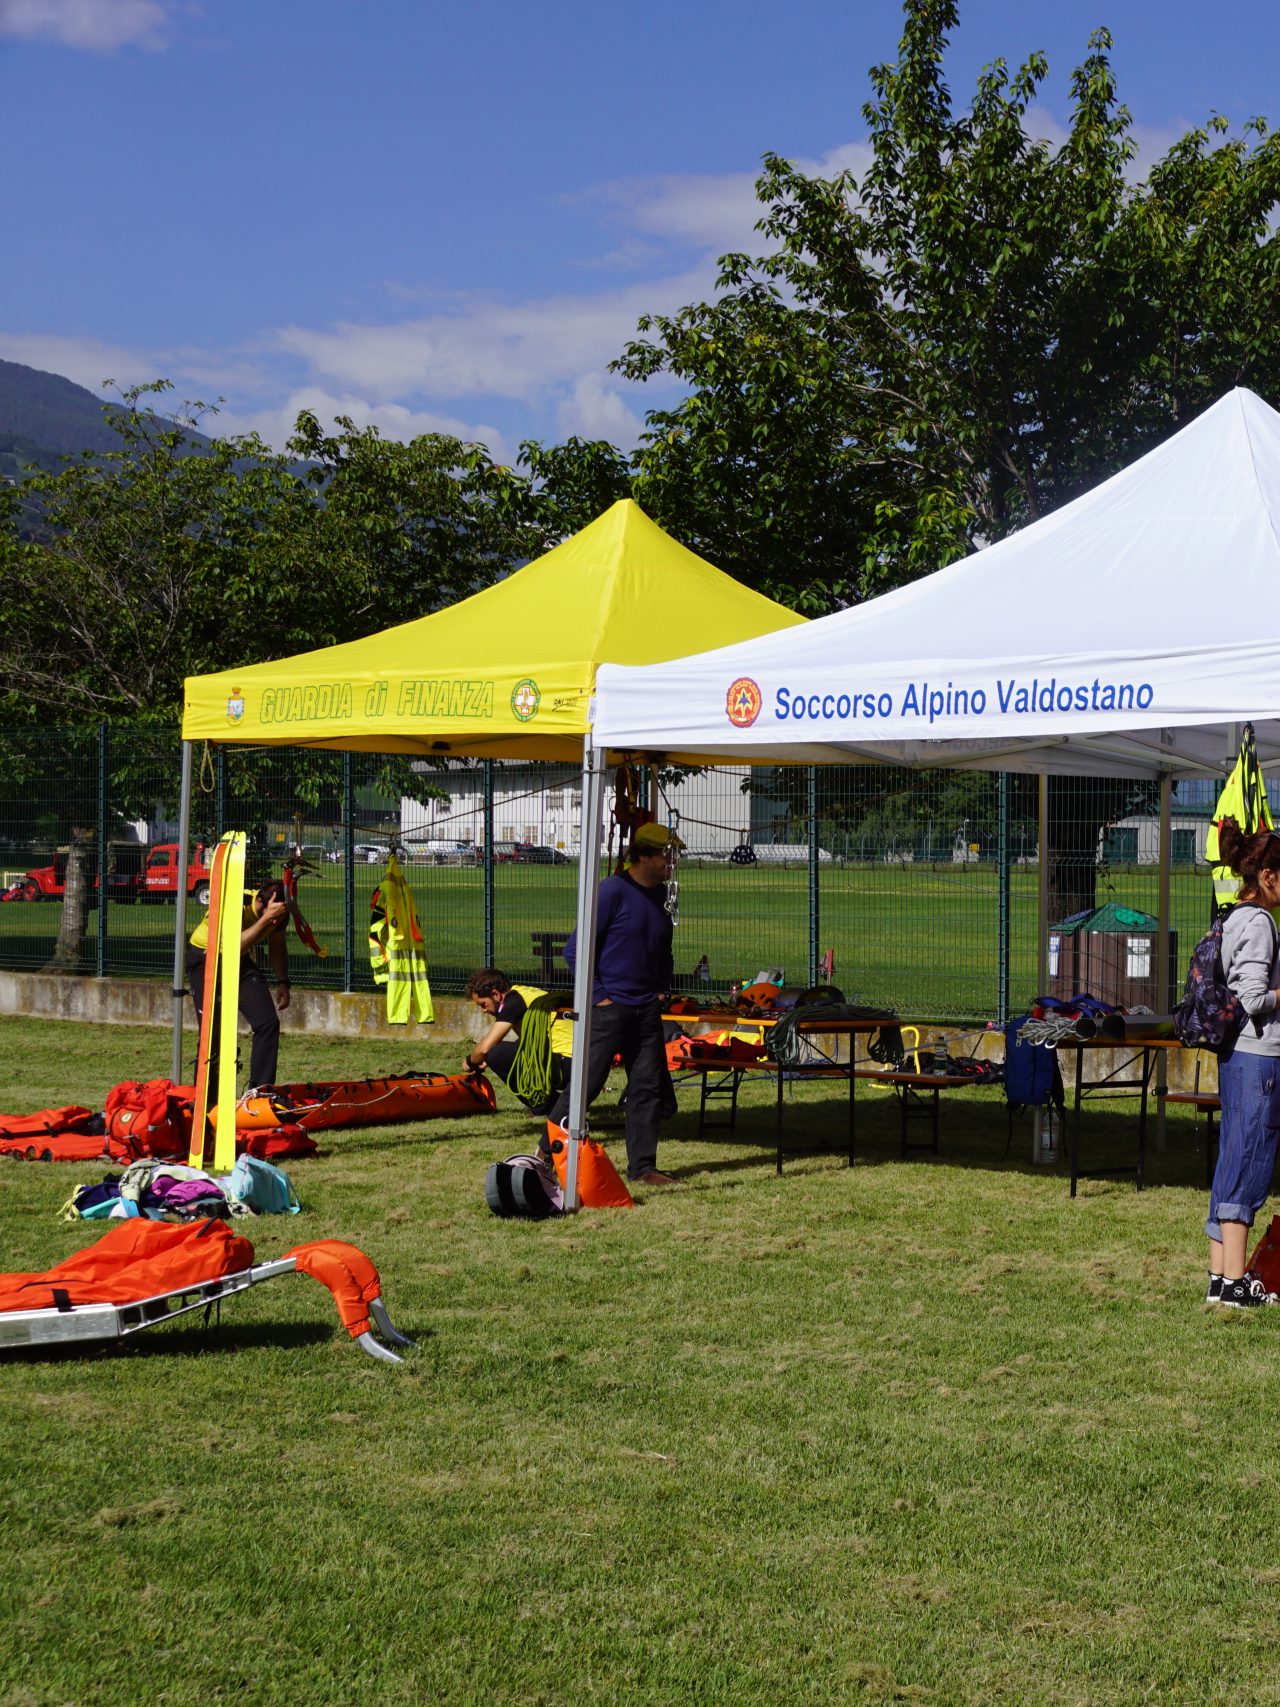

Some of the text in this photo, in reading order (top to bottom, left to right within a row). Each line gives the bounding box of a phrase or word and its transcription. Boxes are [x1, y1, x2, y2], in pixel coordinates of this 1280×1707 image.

[260, 683, 353, 724] GUARDIA
[365, 680, 388, 717] di
[396, 680, 495, 718] FINANZA
[774, 687, 893, 720] Soccorso
[901, 681, 986, 723] Alpino
[996, 677, 1154, 714] Valdostano
